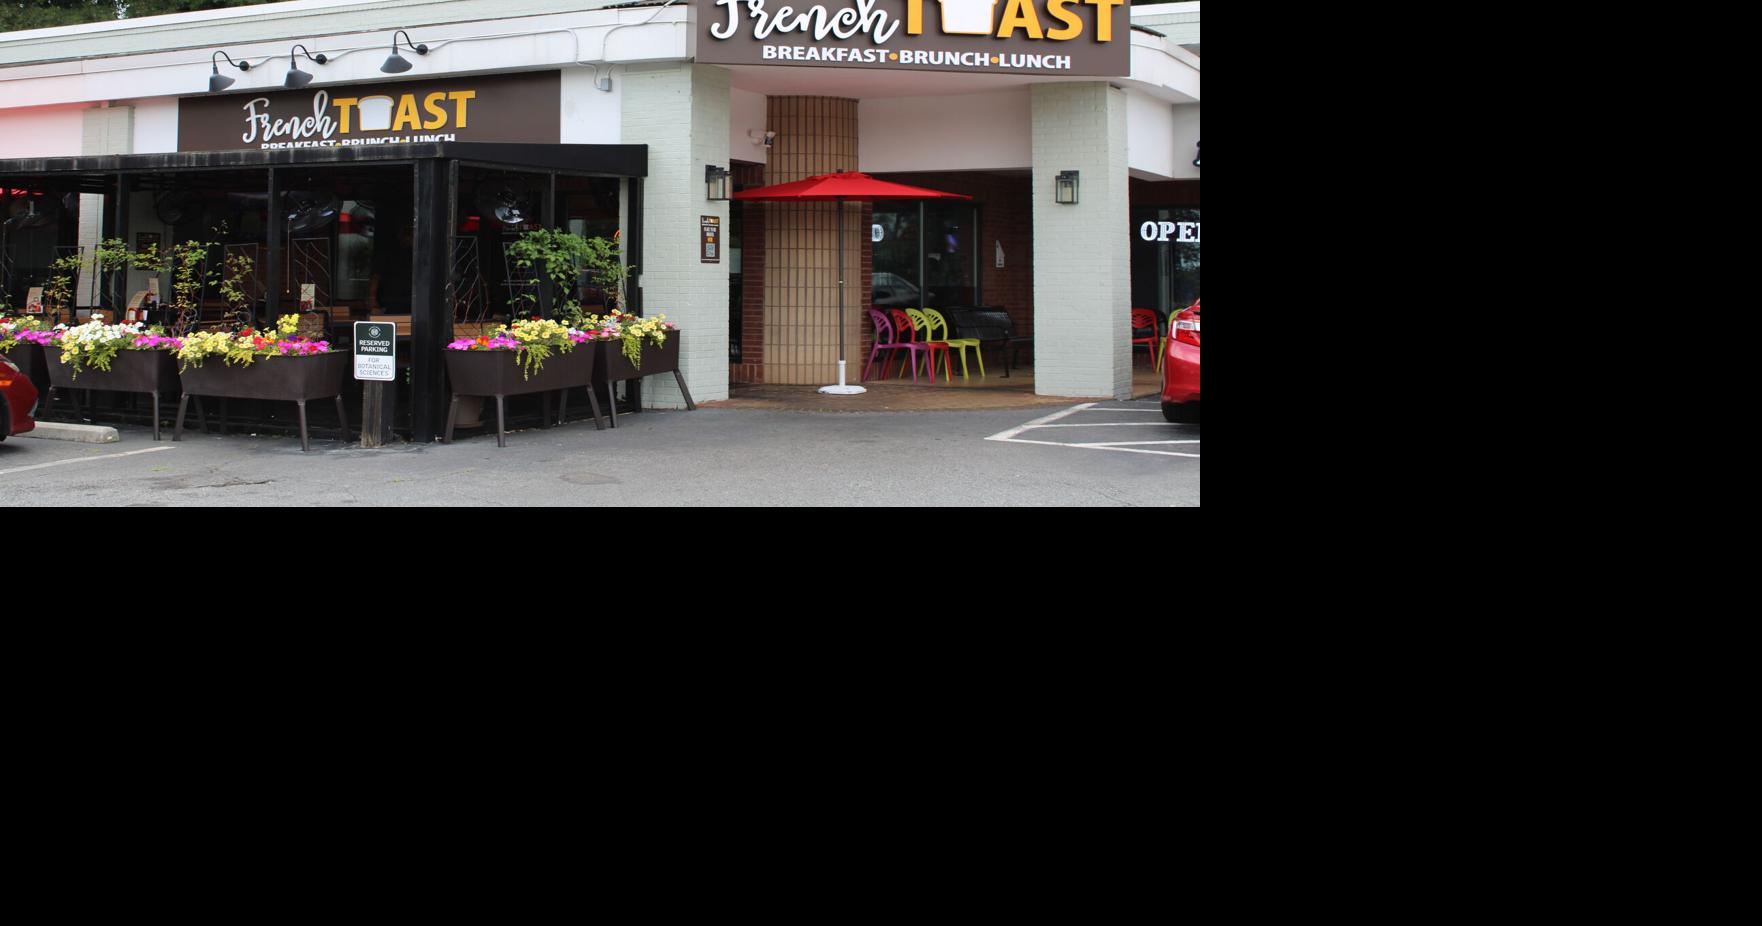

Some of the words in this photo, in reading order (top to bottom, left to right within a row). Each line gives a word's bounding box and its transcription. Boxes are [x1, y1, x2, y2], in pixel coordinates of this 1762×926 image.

[763, 45, 890, 63] BREAKFAST
[899, 49, 990, 67] BRUNCH
[999, 53, 1071, 70] LUNCH
[242, 90, 337, 144] French
[1140, 221, 1200, 242] OPE
